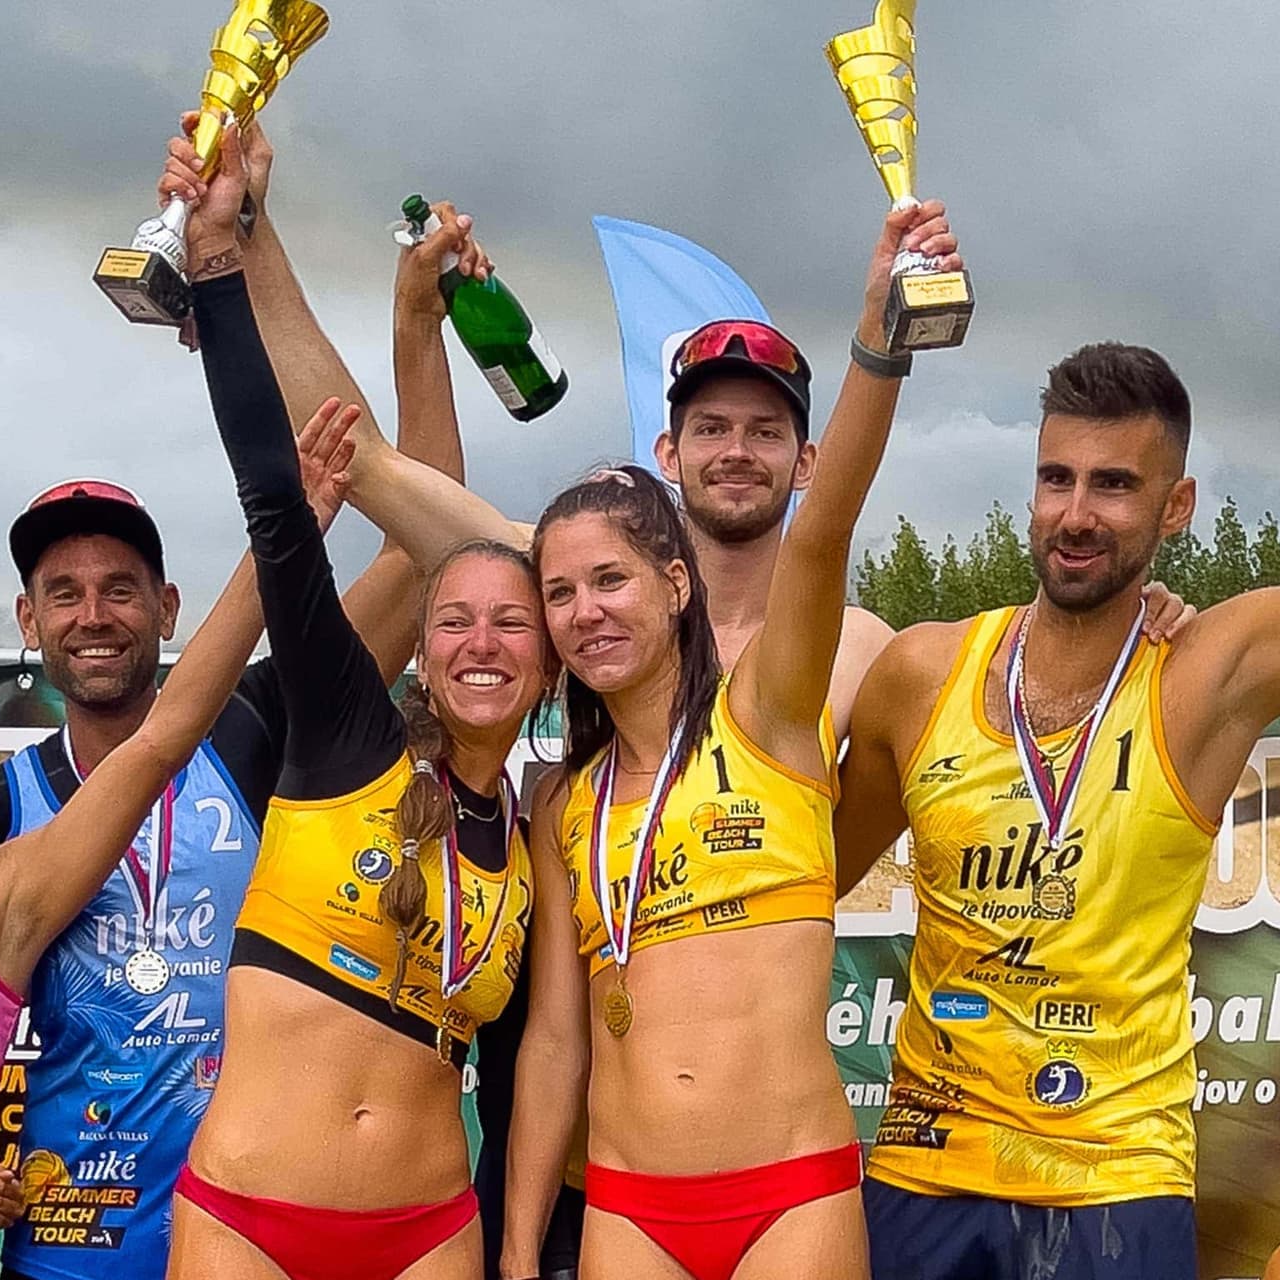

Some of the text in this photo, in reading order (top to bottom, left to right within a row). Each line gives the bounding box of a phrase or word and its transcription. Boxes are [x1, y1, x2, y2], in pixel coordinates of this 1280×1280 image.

[711, 744, 734, 794] 1
[1111, 729, 1134, 792] 1
[195, 797, 242, 852] 2
[959, 822, 1084, 891] niké
[610, 842, 689, 912] nké
[710, 900, 746, 921] PERI
[962, 969, 999, 983] Auto
[1045, 1002, 1095, 1027] PERI
[122, 1035, 161, 1049] Auto
[1255, 1079, 1276, 1103] o
[76, 1150, 136, 1181] niké
[44, 1188, 136, 1206] SUMMER
[27, 1207, 96, 1224] BEACH
[33, 1227, 87, 1245] TOUR
